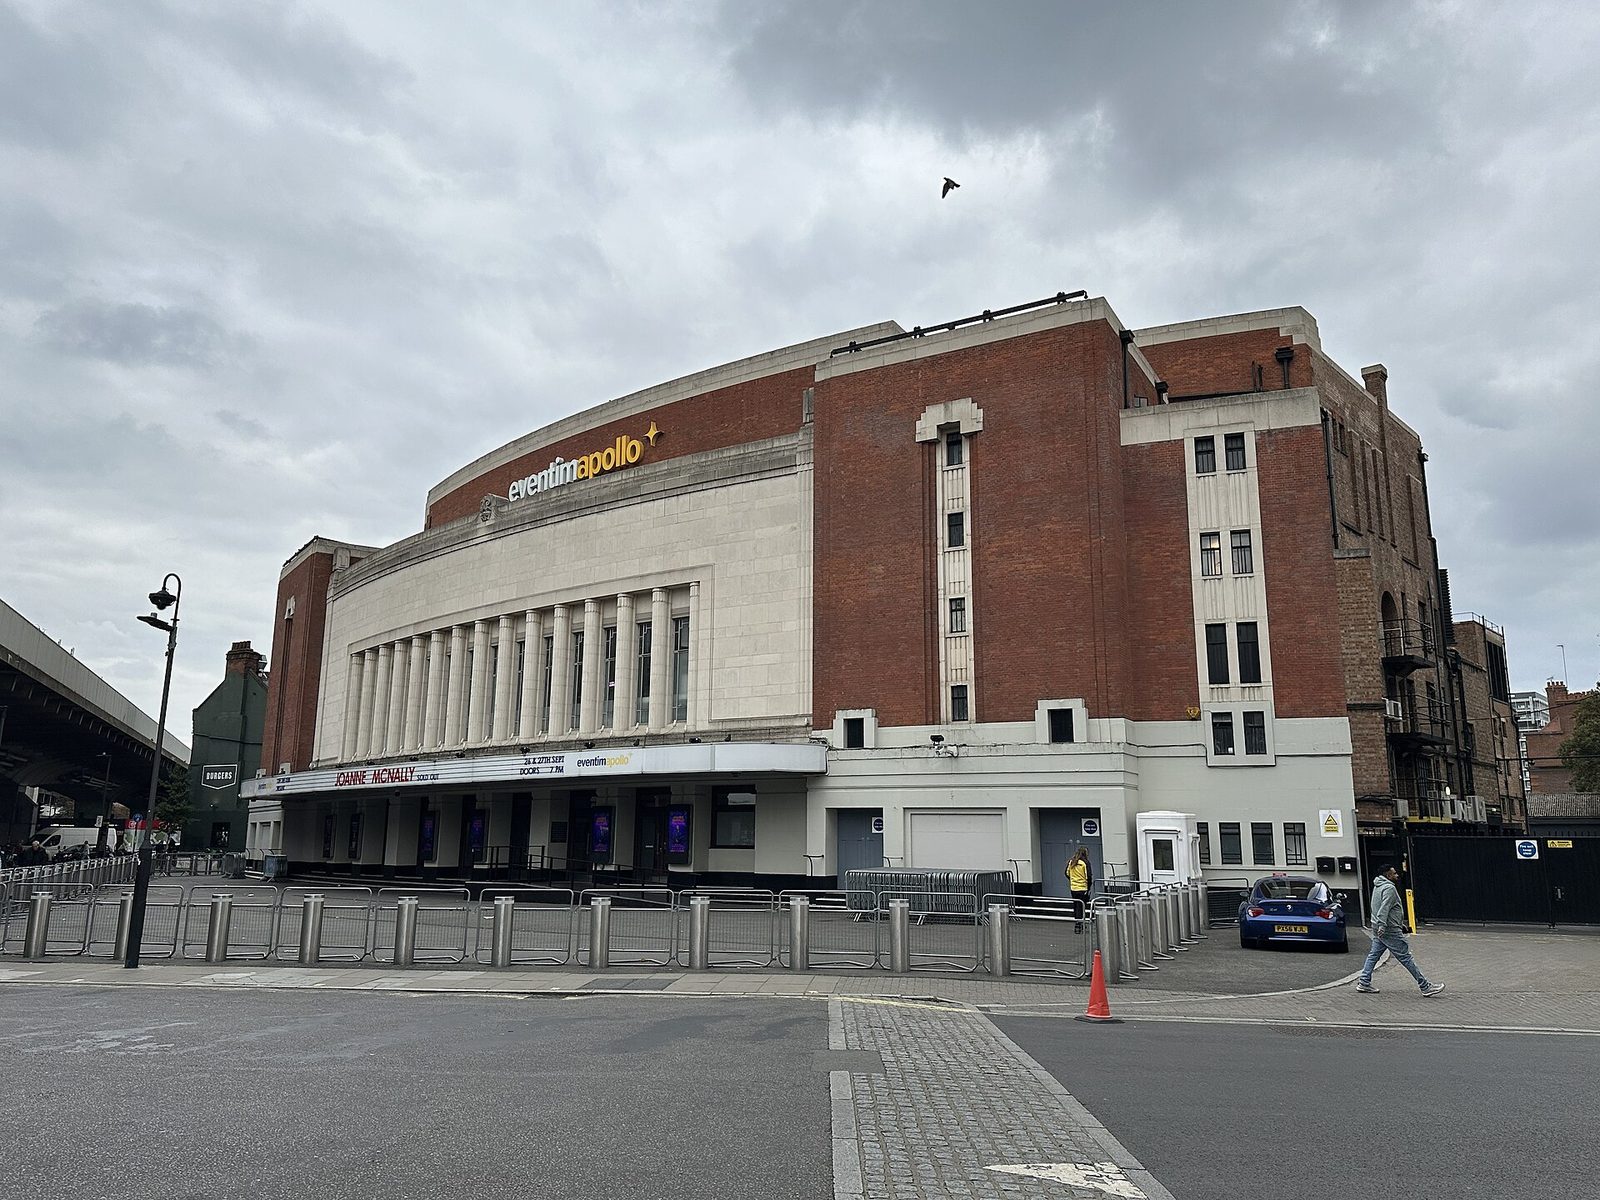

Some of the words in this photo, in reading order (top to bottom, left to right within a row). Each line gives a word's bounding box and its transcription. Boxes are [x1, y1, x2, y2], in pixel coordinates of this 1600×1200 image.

[206, 771, 233, 780] BURGERS
[519, 767, 540, 775] DOORS
[335, 771, 366, 786] JOANNE
[372, 767, 415, 784] MCNALLY
